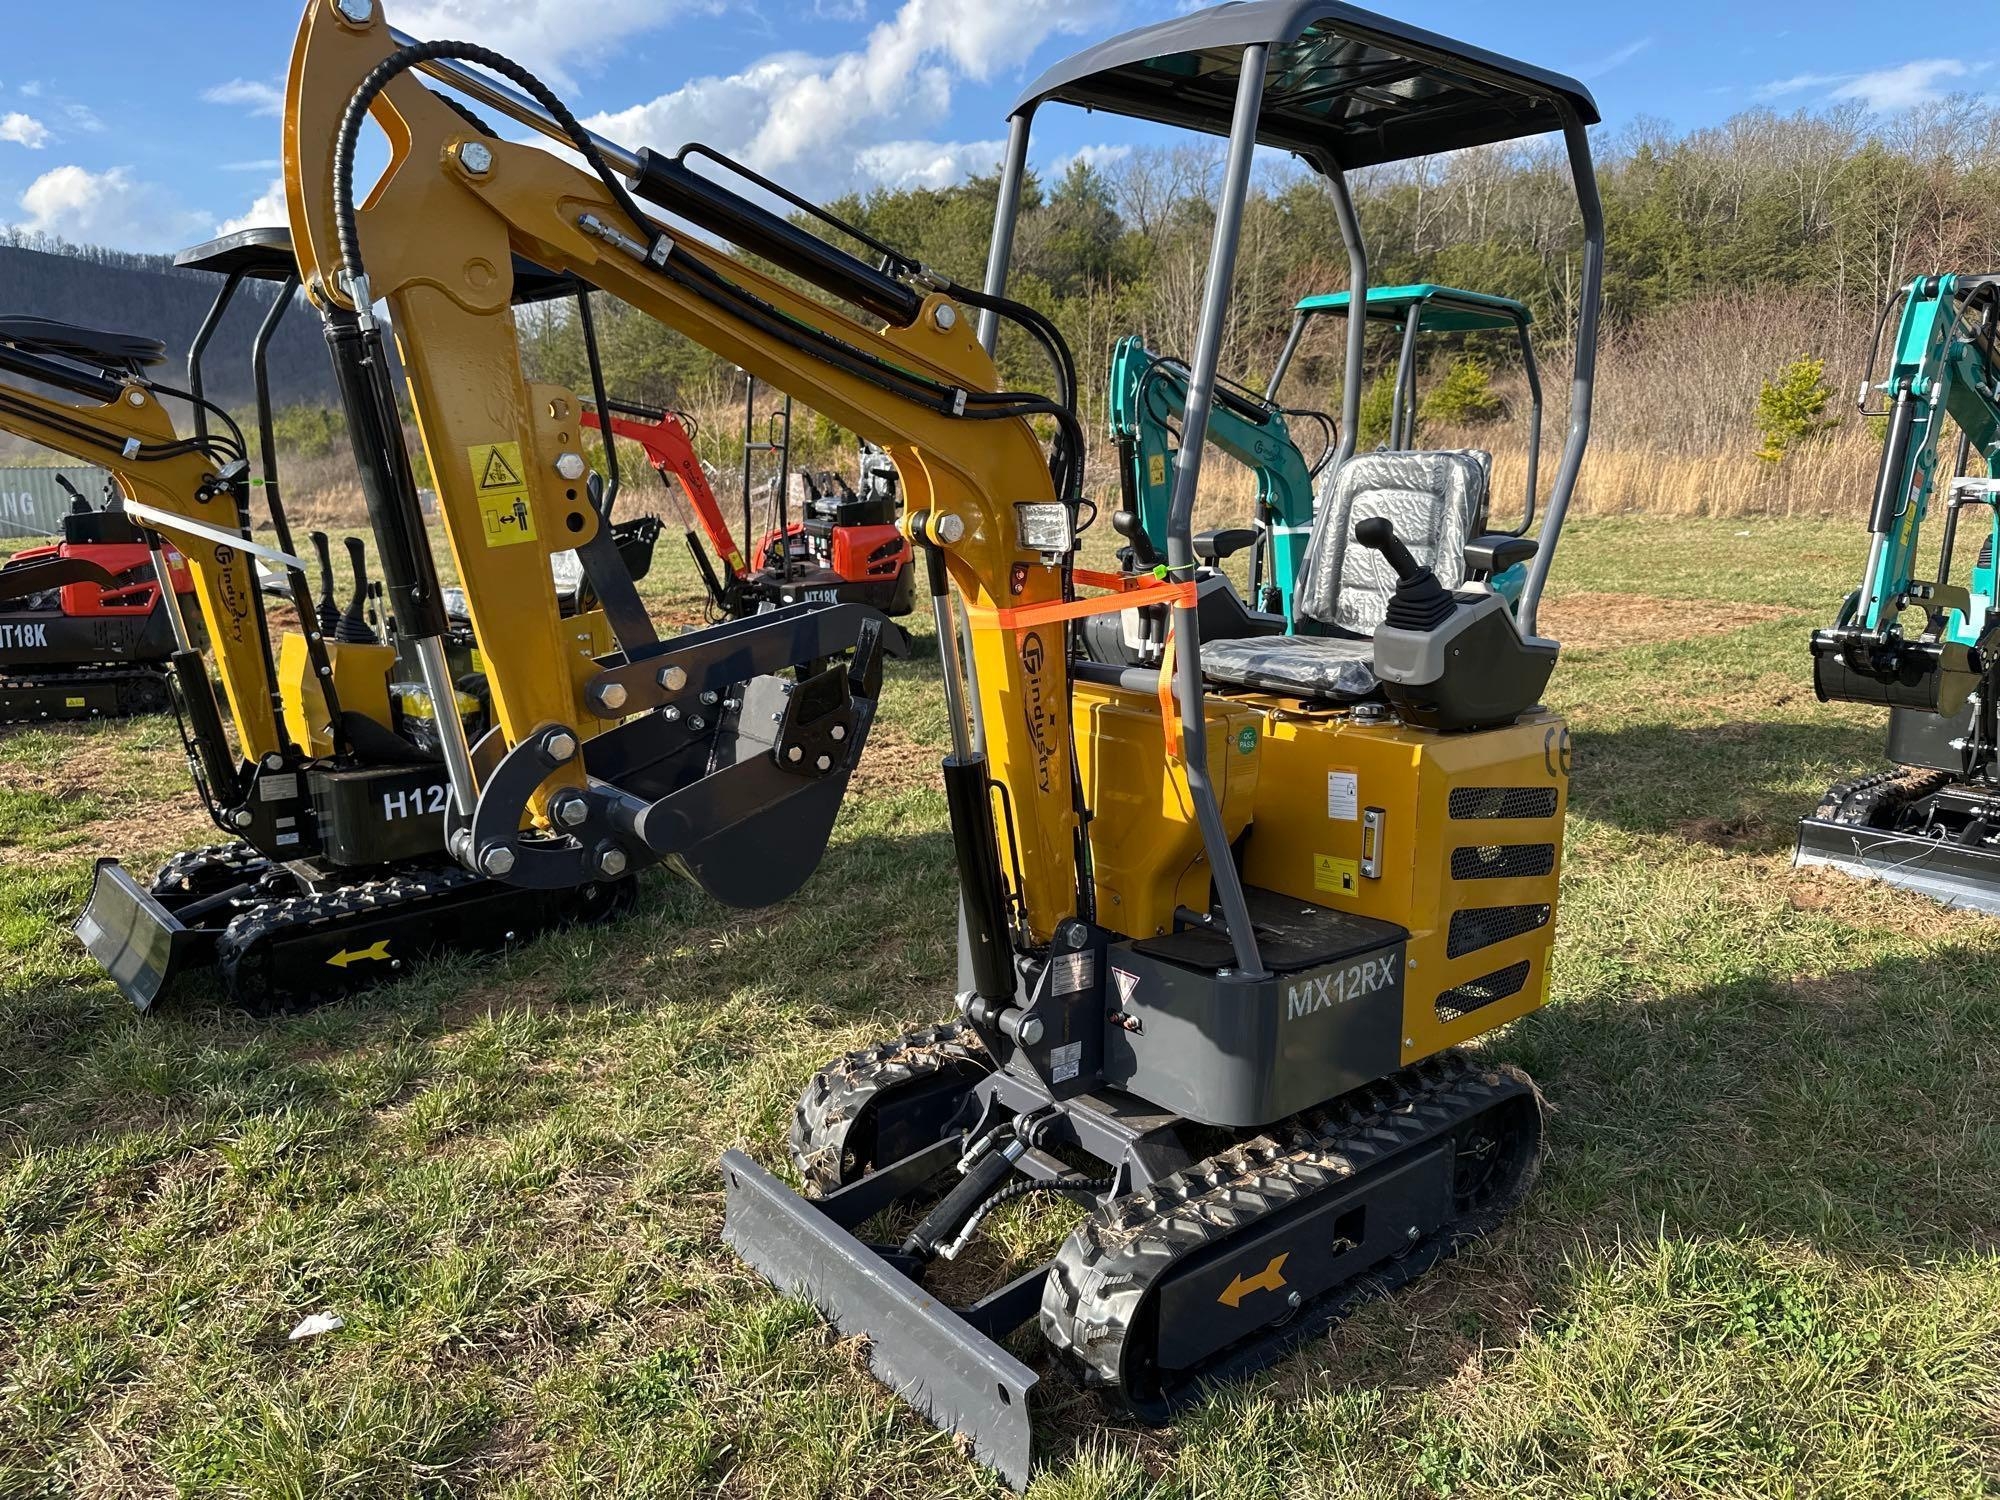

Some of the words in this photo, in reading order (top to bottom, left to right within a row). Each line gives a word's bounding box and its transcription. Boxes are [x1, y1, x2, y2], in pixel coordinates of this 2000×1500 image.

[0, 492, 35, 517] NG
[383, 783, 453, 821] H12
[1288, 952, 1396, 1021] MX12RX
